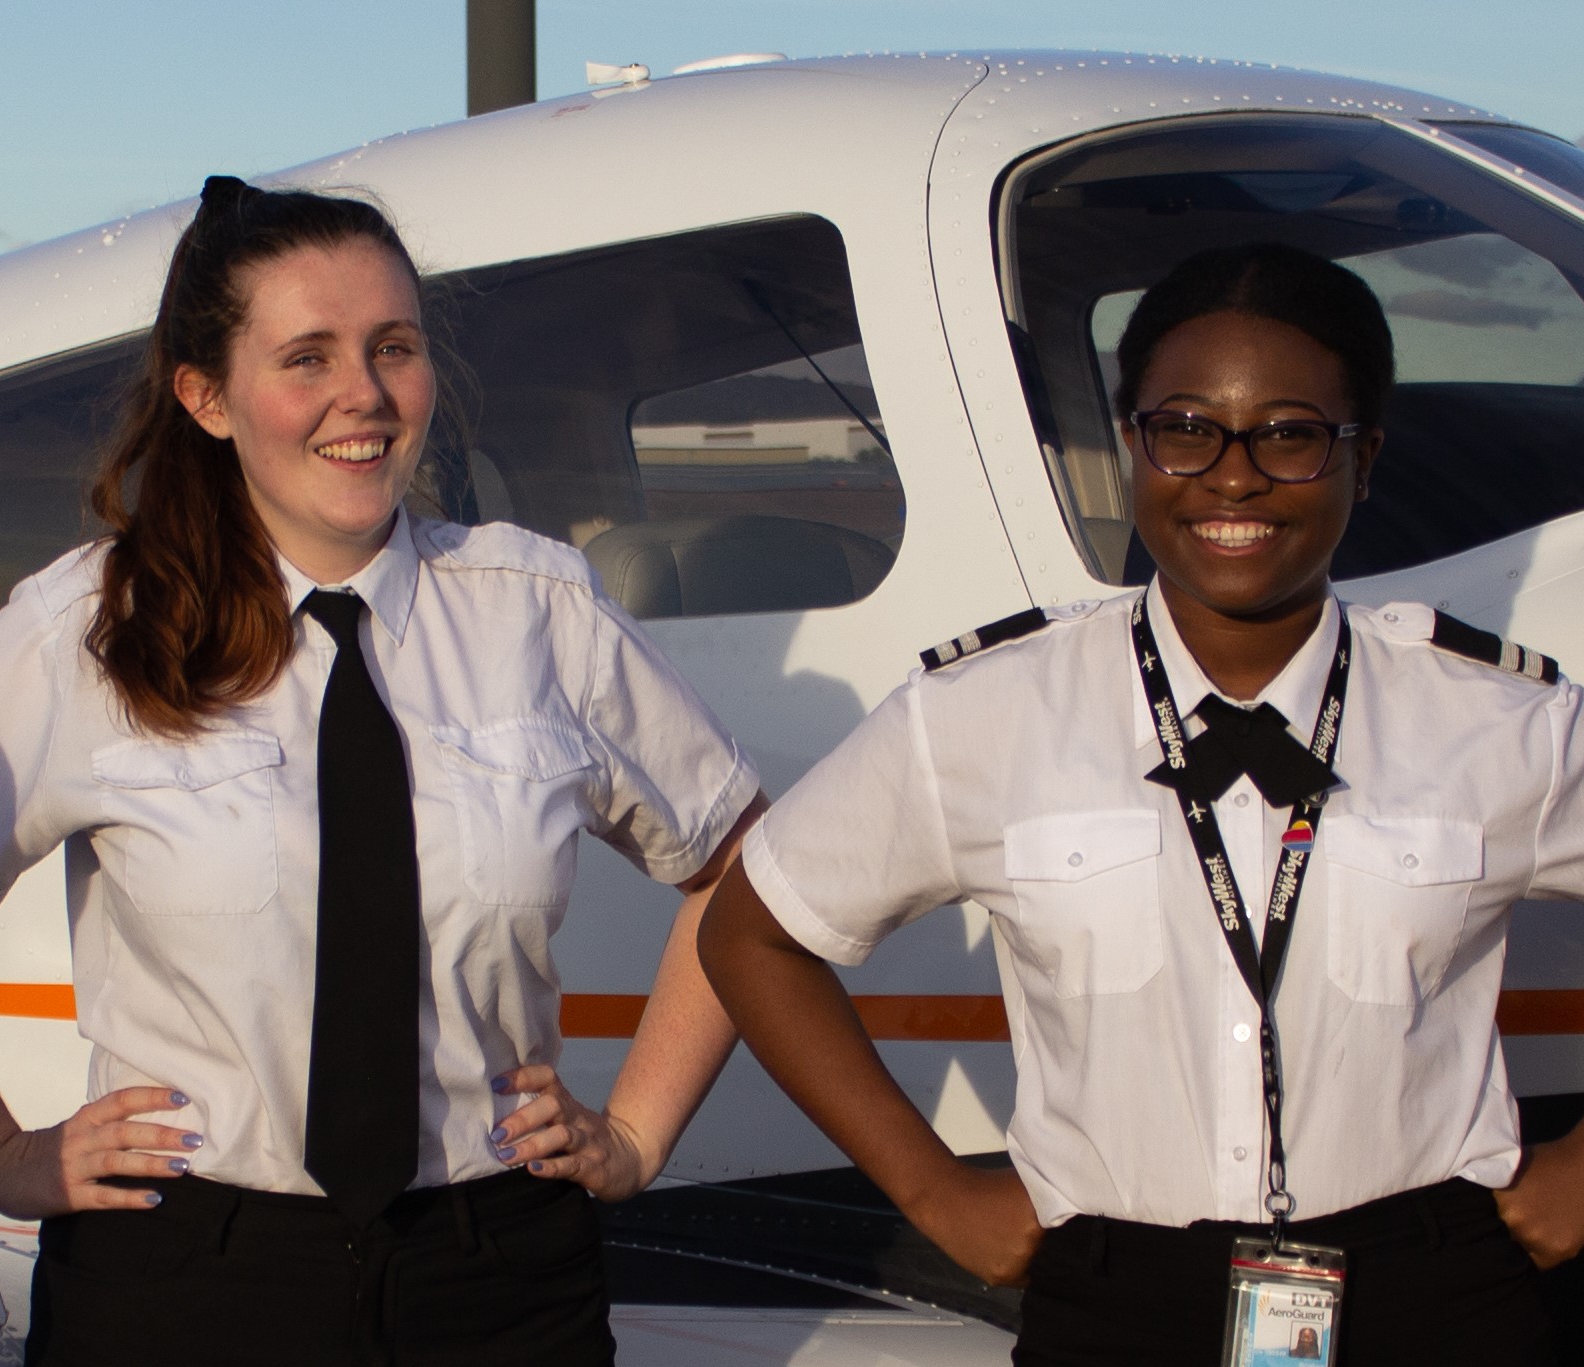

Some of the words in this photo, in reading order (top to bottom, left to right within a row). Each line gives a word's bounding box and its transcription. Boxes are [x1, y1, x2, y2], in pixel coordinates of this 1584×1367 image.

[1154, 702, 1186, 770] SkyWest
[1315, 696, 1340, 763] SkyWest
[1205, 857, 1239, 931] SkyWest
[1274, 850, 1305, 922] SkyWest
[1268, 1307, 1324, 1321] AeroGuard
[1295, 1294, 1330, 1308] DVT
